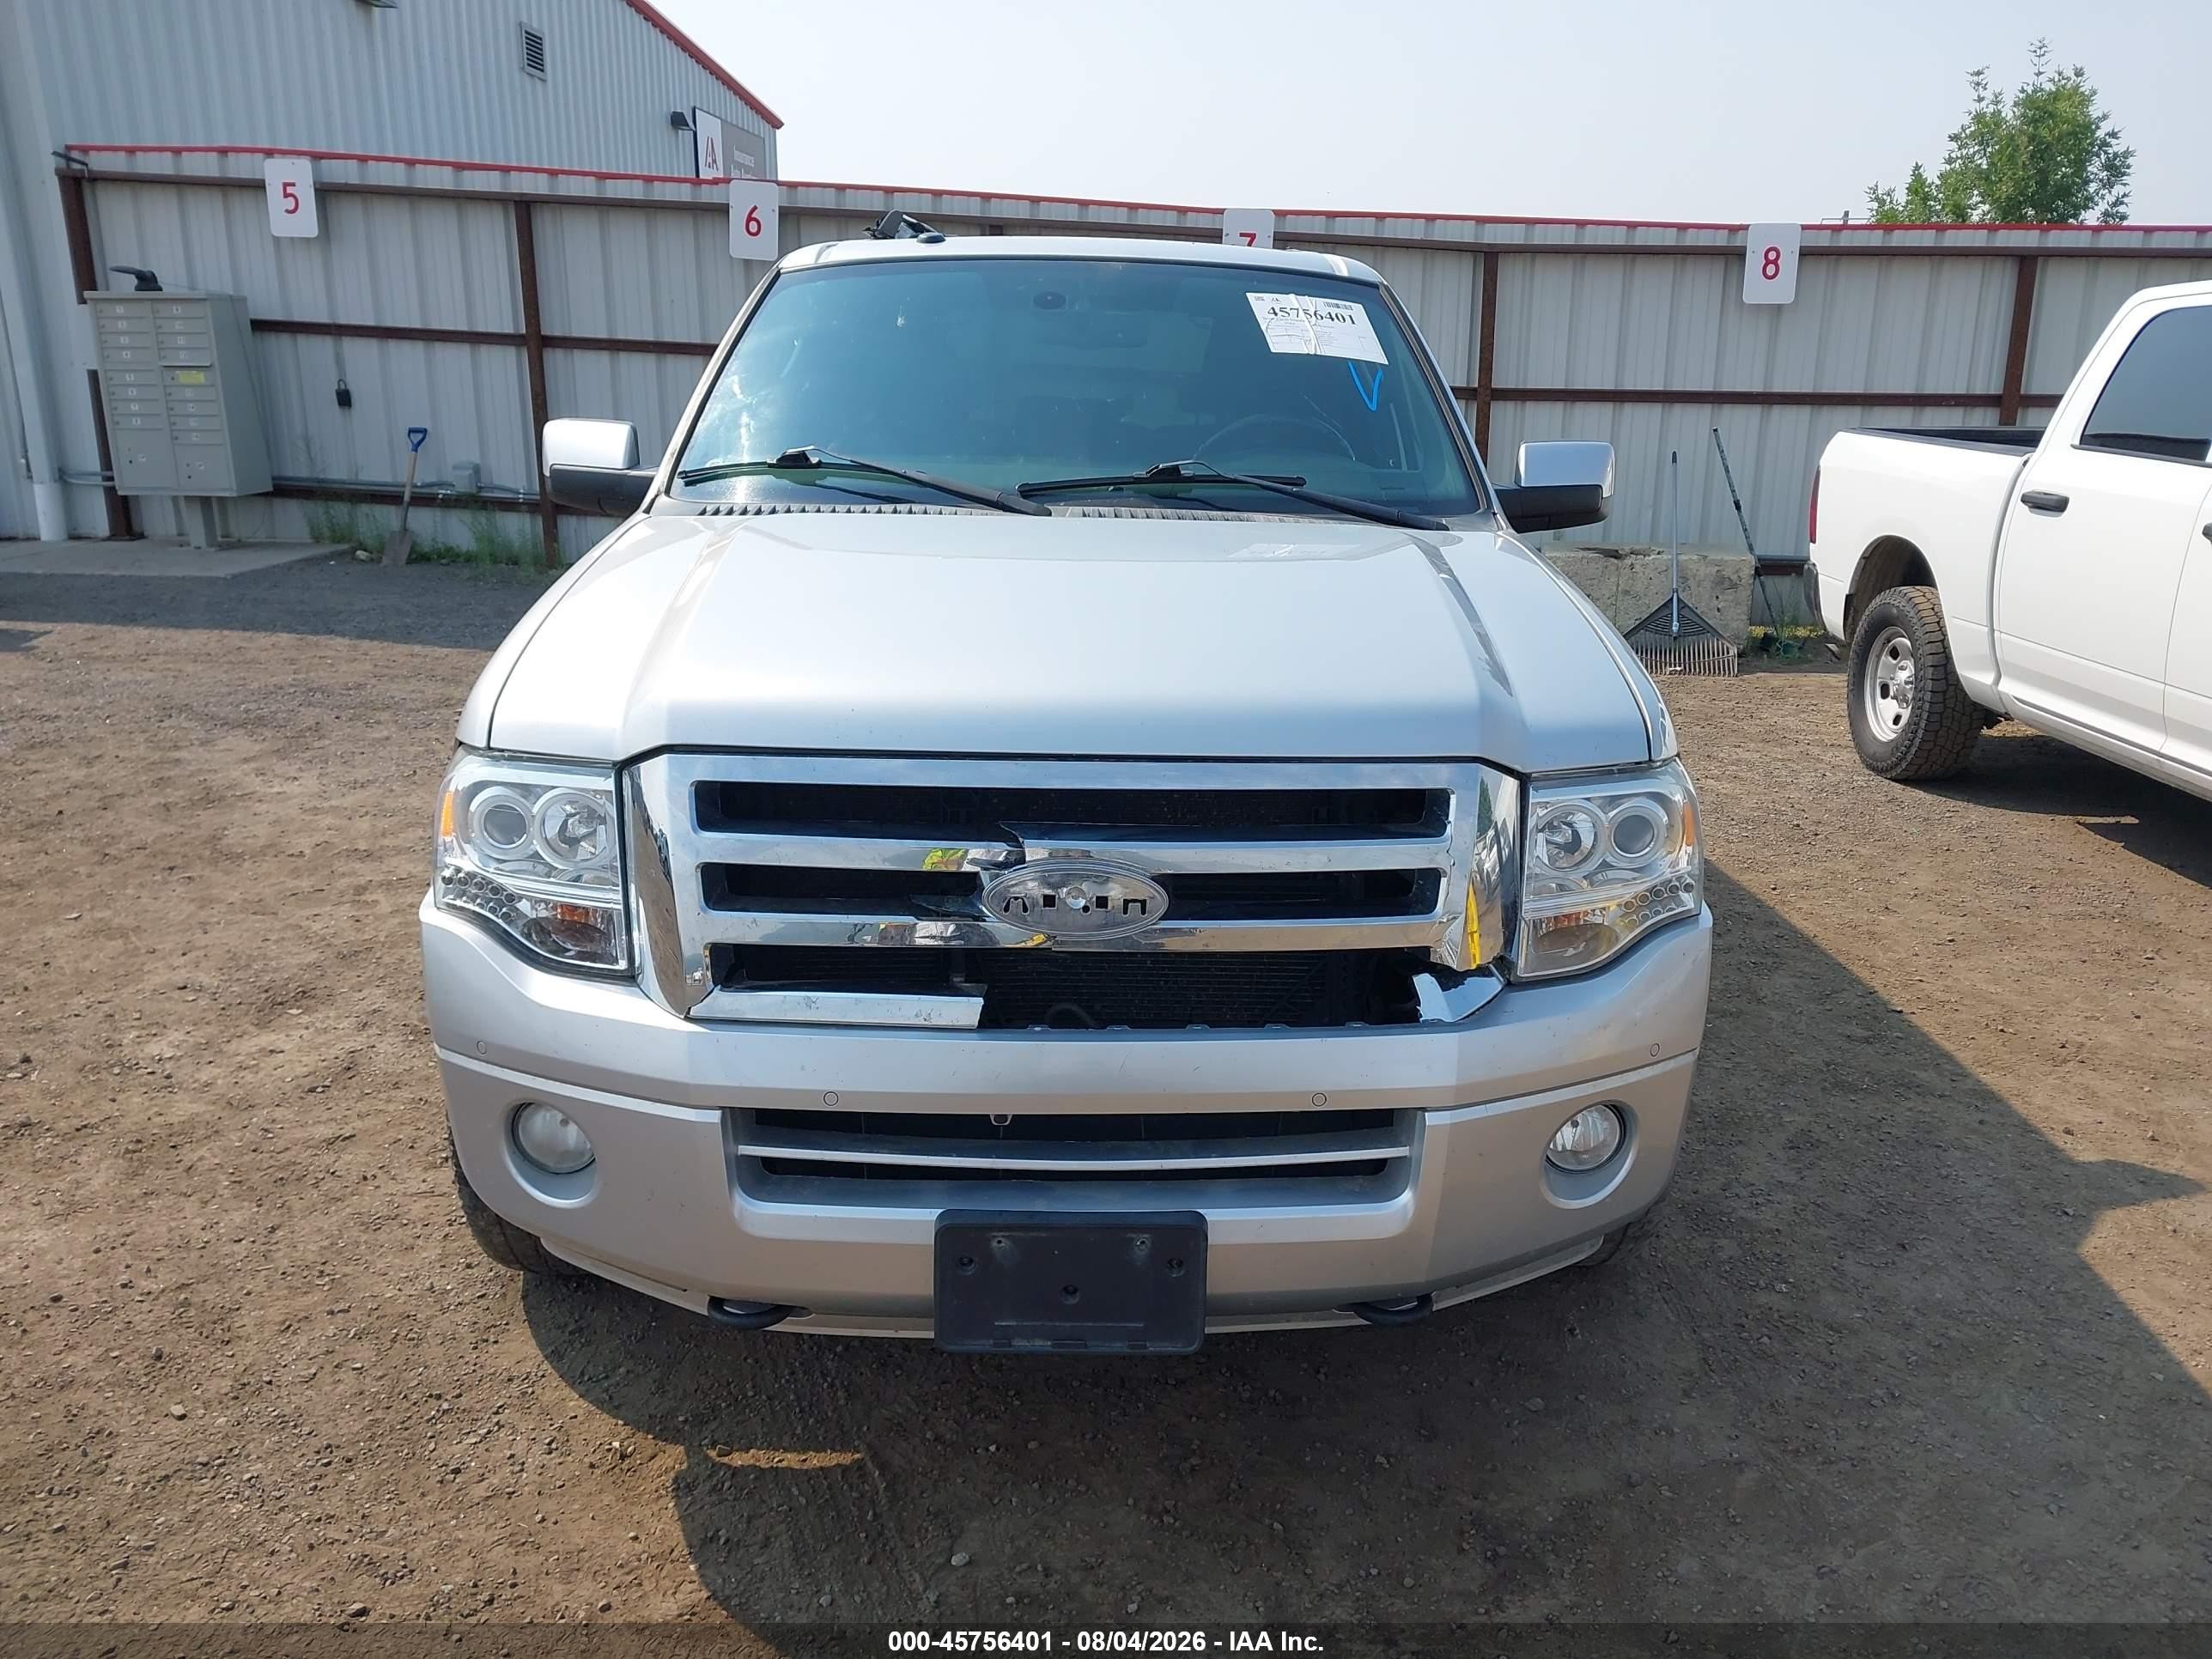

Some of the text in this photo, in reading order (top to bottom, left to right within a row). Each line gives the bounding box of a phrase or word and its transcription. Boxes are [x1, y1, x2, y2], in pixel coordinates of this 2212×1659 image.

[281, 181, 300, 215] 5
[744, 204, 762, 237] 6
[1238, 232, 1257, 247] 7
[1761, 246, 1781, 281] 8
[1267, 306, 1358, 325] 45756401
